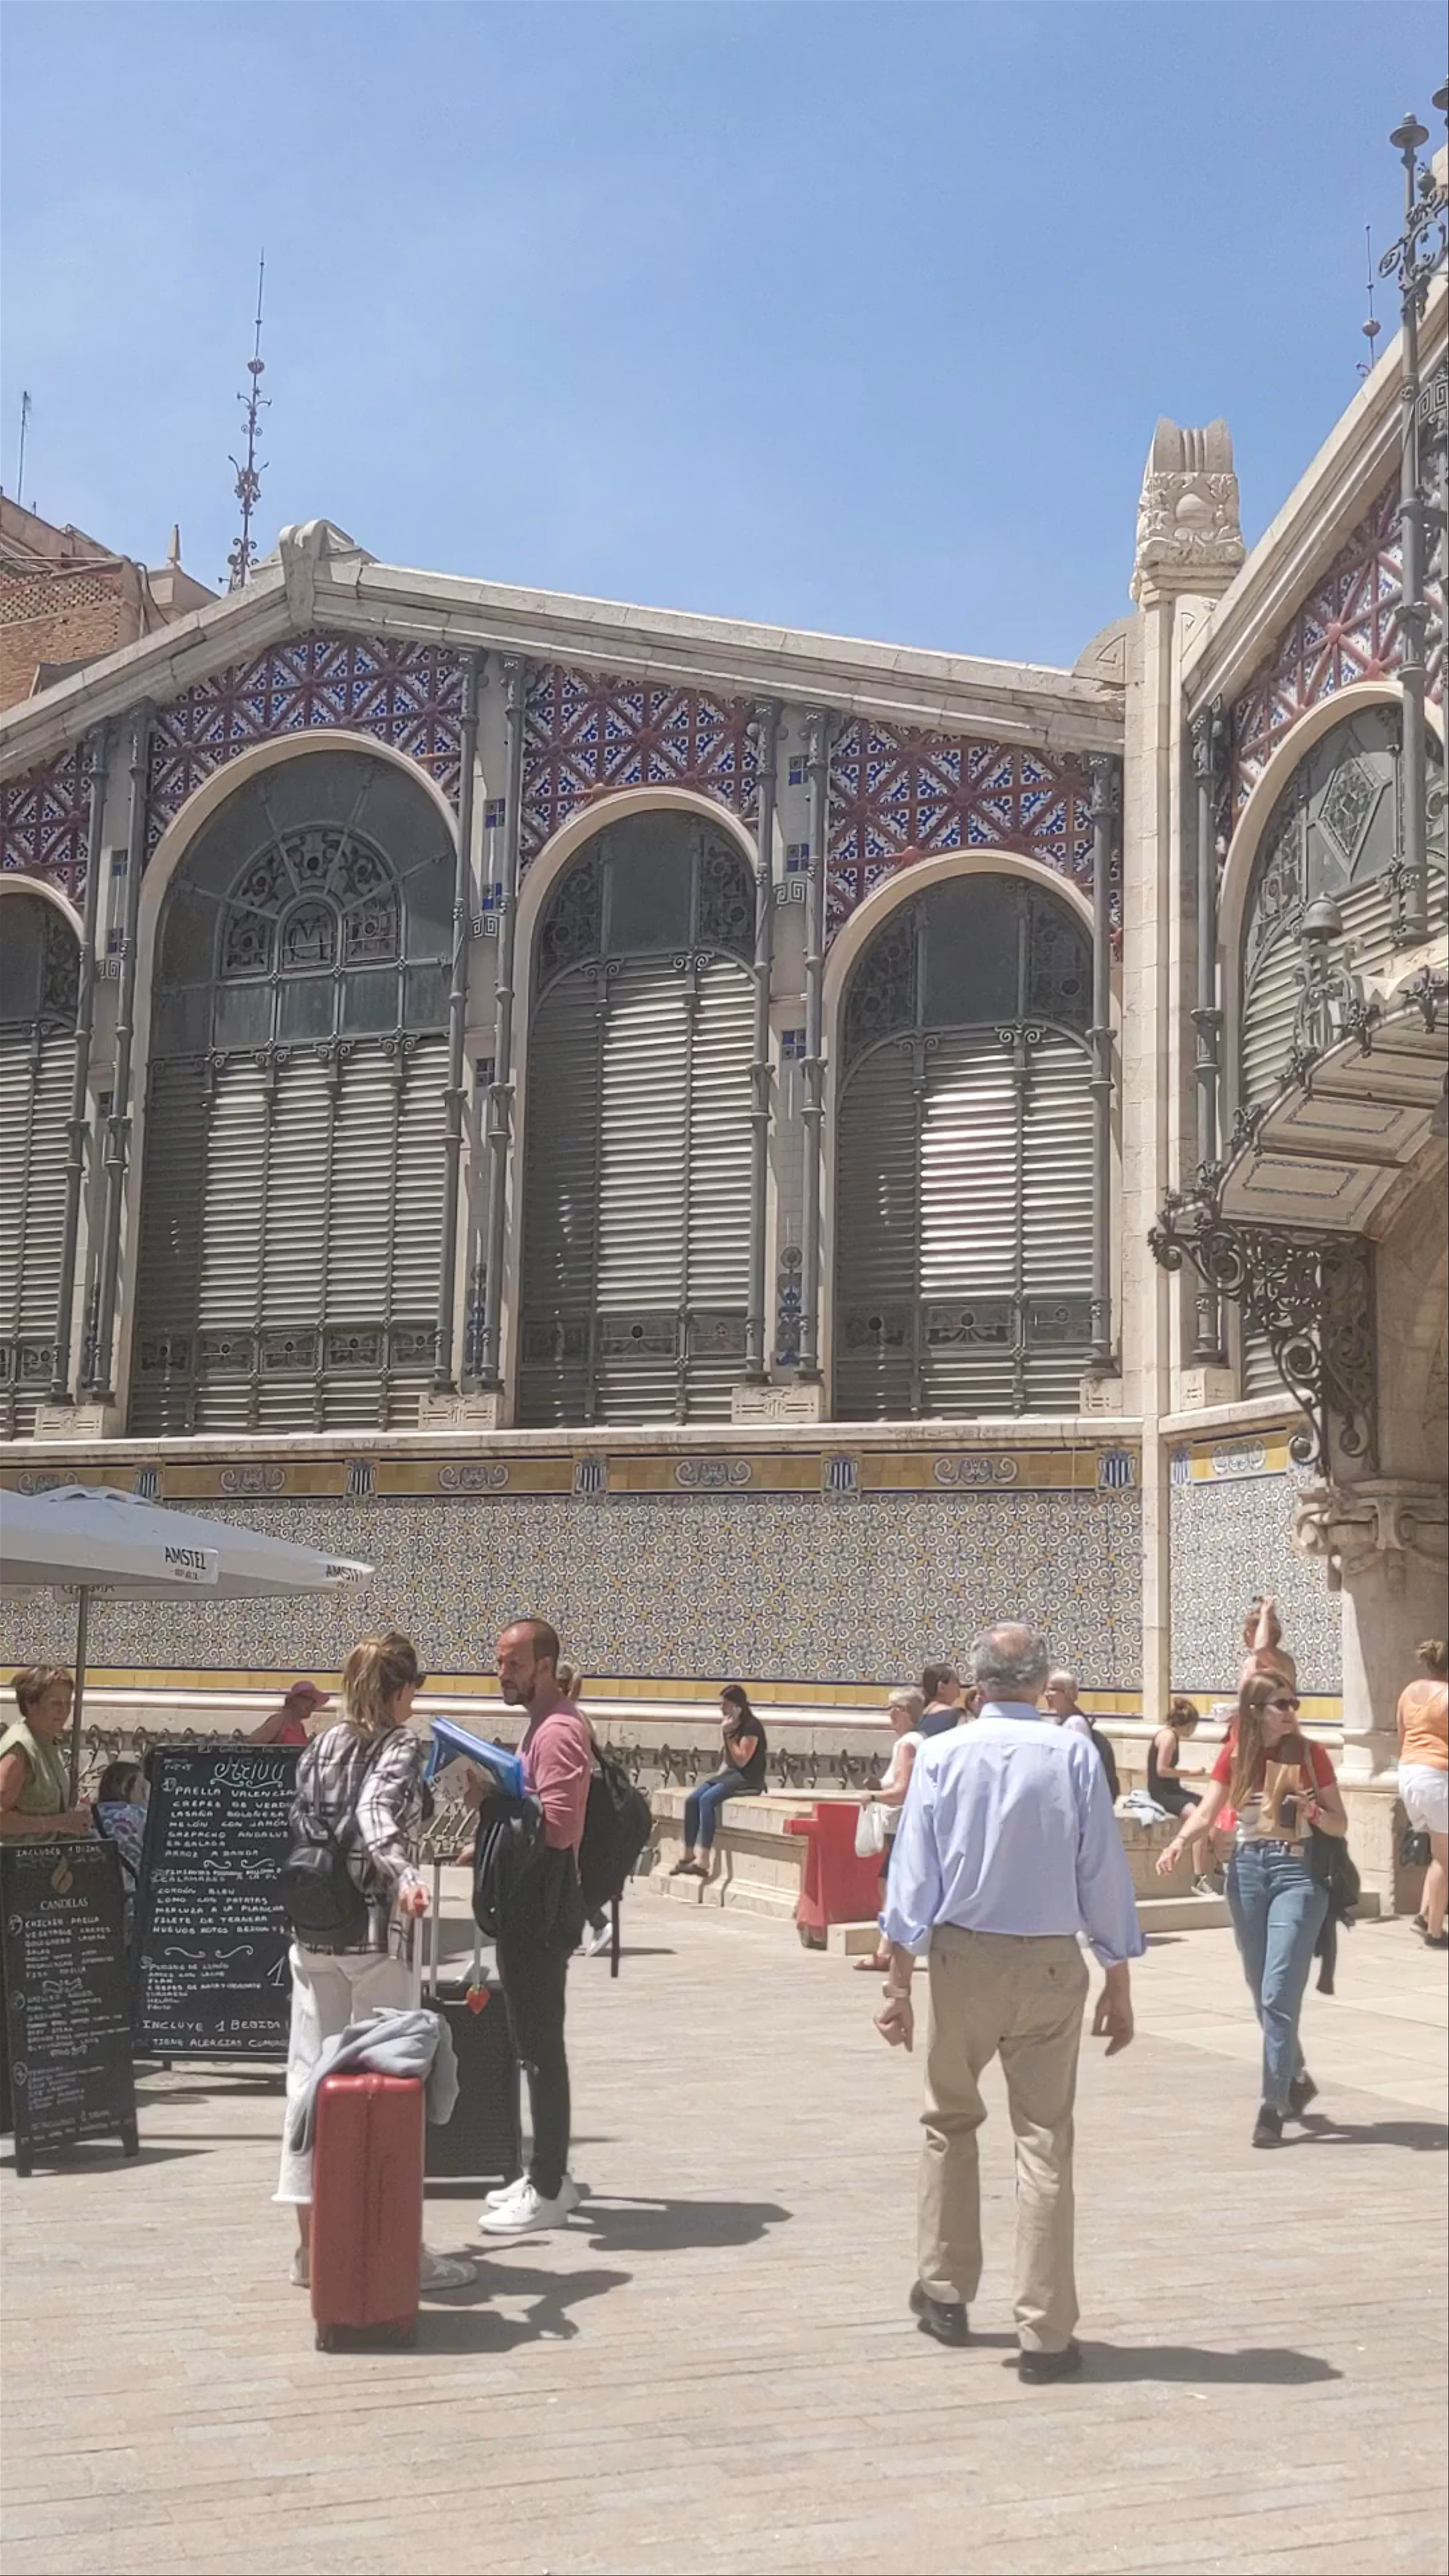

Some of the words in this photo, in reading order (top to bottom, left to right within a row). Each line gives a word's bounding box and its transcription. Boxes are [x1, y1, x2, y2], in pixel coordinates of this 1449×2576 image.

[165, 1546, 206, 1570] AMSTEL
[175, 1786, 222, 1796] PAELLA
[172, 1800, 222, 1808] CREPES
[40, 1897, 89, 1910] CANDELAS
[226, 1896, 268, 1905] PATATAS
[71, 1916, 100, 1925] PAELLA
[142, 2019, 203, 2032] INCLUYE
[215, 2020, 226, 2032] 1
[230, 2019, 281, 2031] BEBIDA
